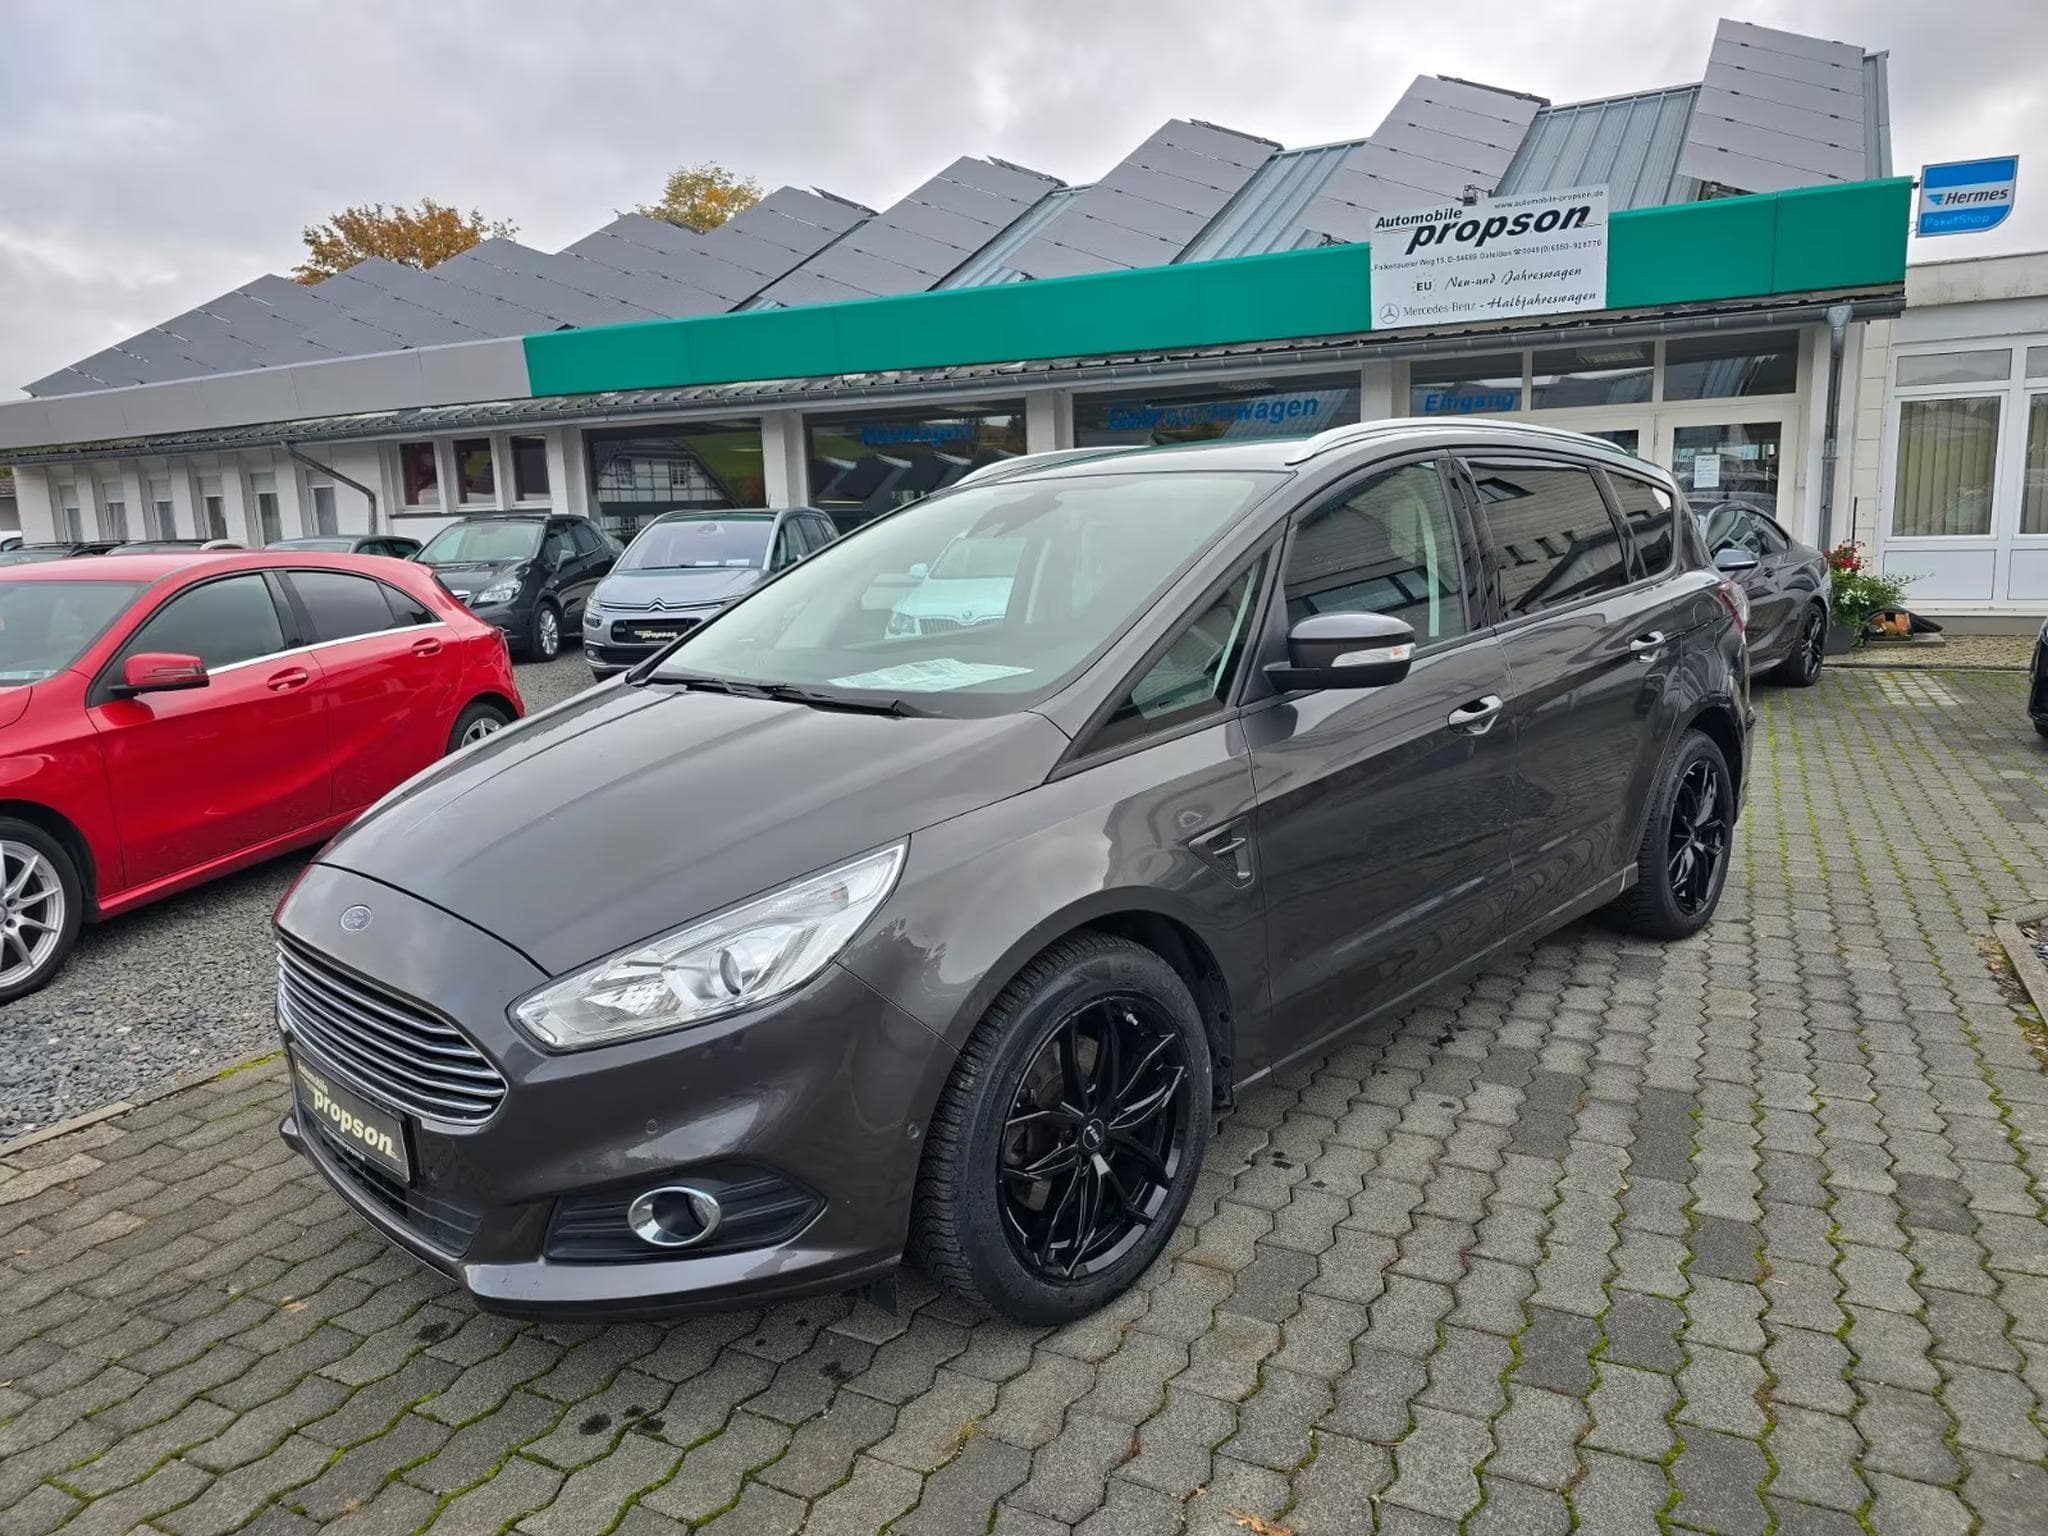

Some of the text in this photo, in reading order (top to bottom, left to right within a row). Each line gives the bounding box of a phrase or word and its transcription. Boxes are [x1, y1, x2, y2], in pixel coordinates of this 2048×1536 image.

[1944, 188, 2009, 205] Hermes
[1375, 207, 1463, 229] Automobile
[1924, 214, 1990, 227] PaketShop
[1404, 205, 1592, 256] propson
[1500, 267, 1582, 287] Jahreswagen
[1416, 282, 1432, 291] EU
[1403, 302, 1476, 317] Mercedes-Benz
[313, 1088, 397, 1158] propson
